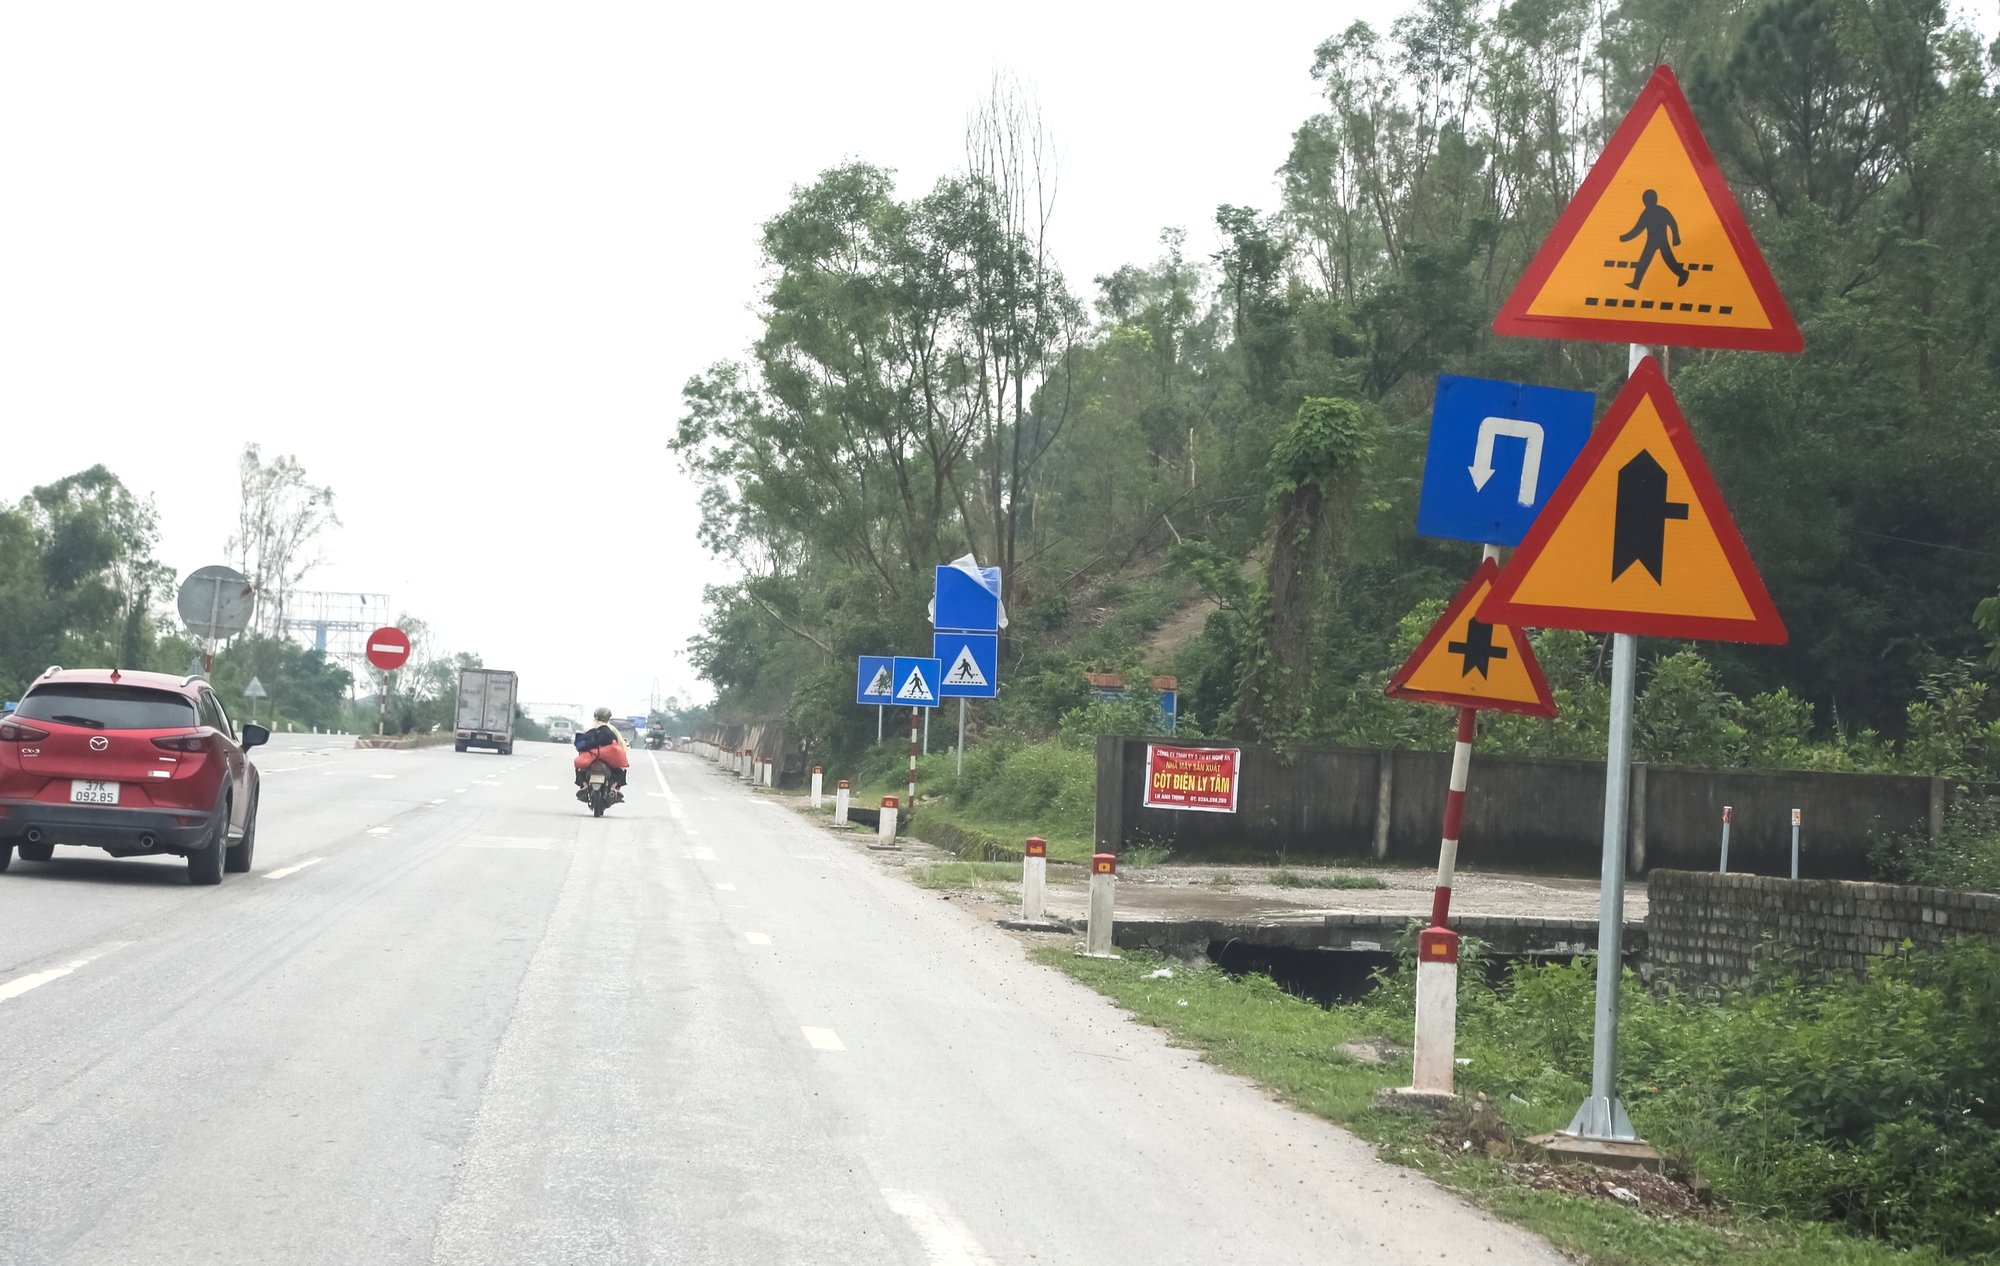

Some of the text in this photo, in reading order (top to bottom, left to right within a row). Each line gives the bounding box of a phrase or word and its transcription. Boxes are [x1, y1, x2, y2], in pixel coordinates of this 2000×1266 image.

[1157, 749, 1169, 757] CÔNG
[1165, 760, 1221, 773] NHÀ MÁY SẢN XUẤT
[85, 781, 106, 791] 37K
[1153, 770, 1230, 794] CỘT ĐIỆN LY TÂM
[75, 791, 114, 802] 092.85
